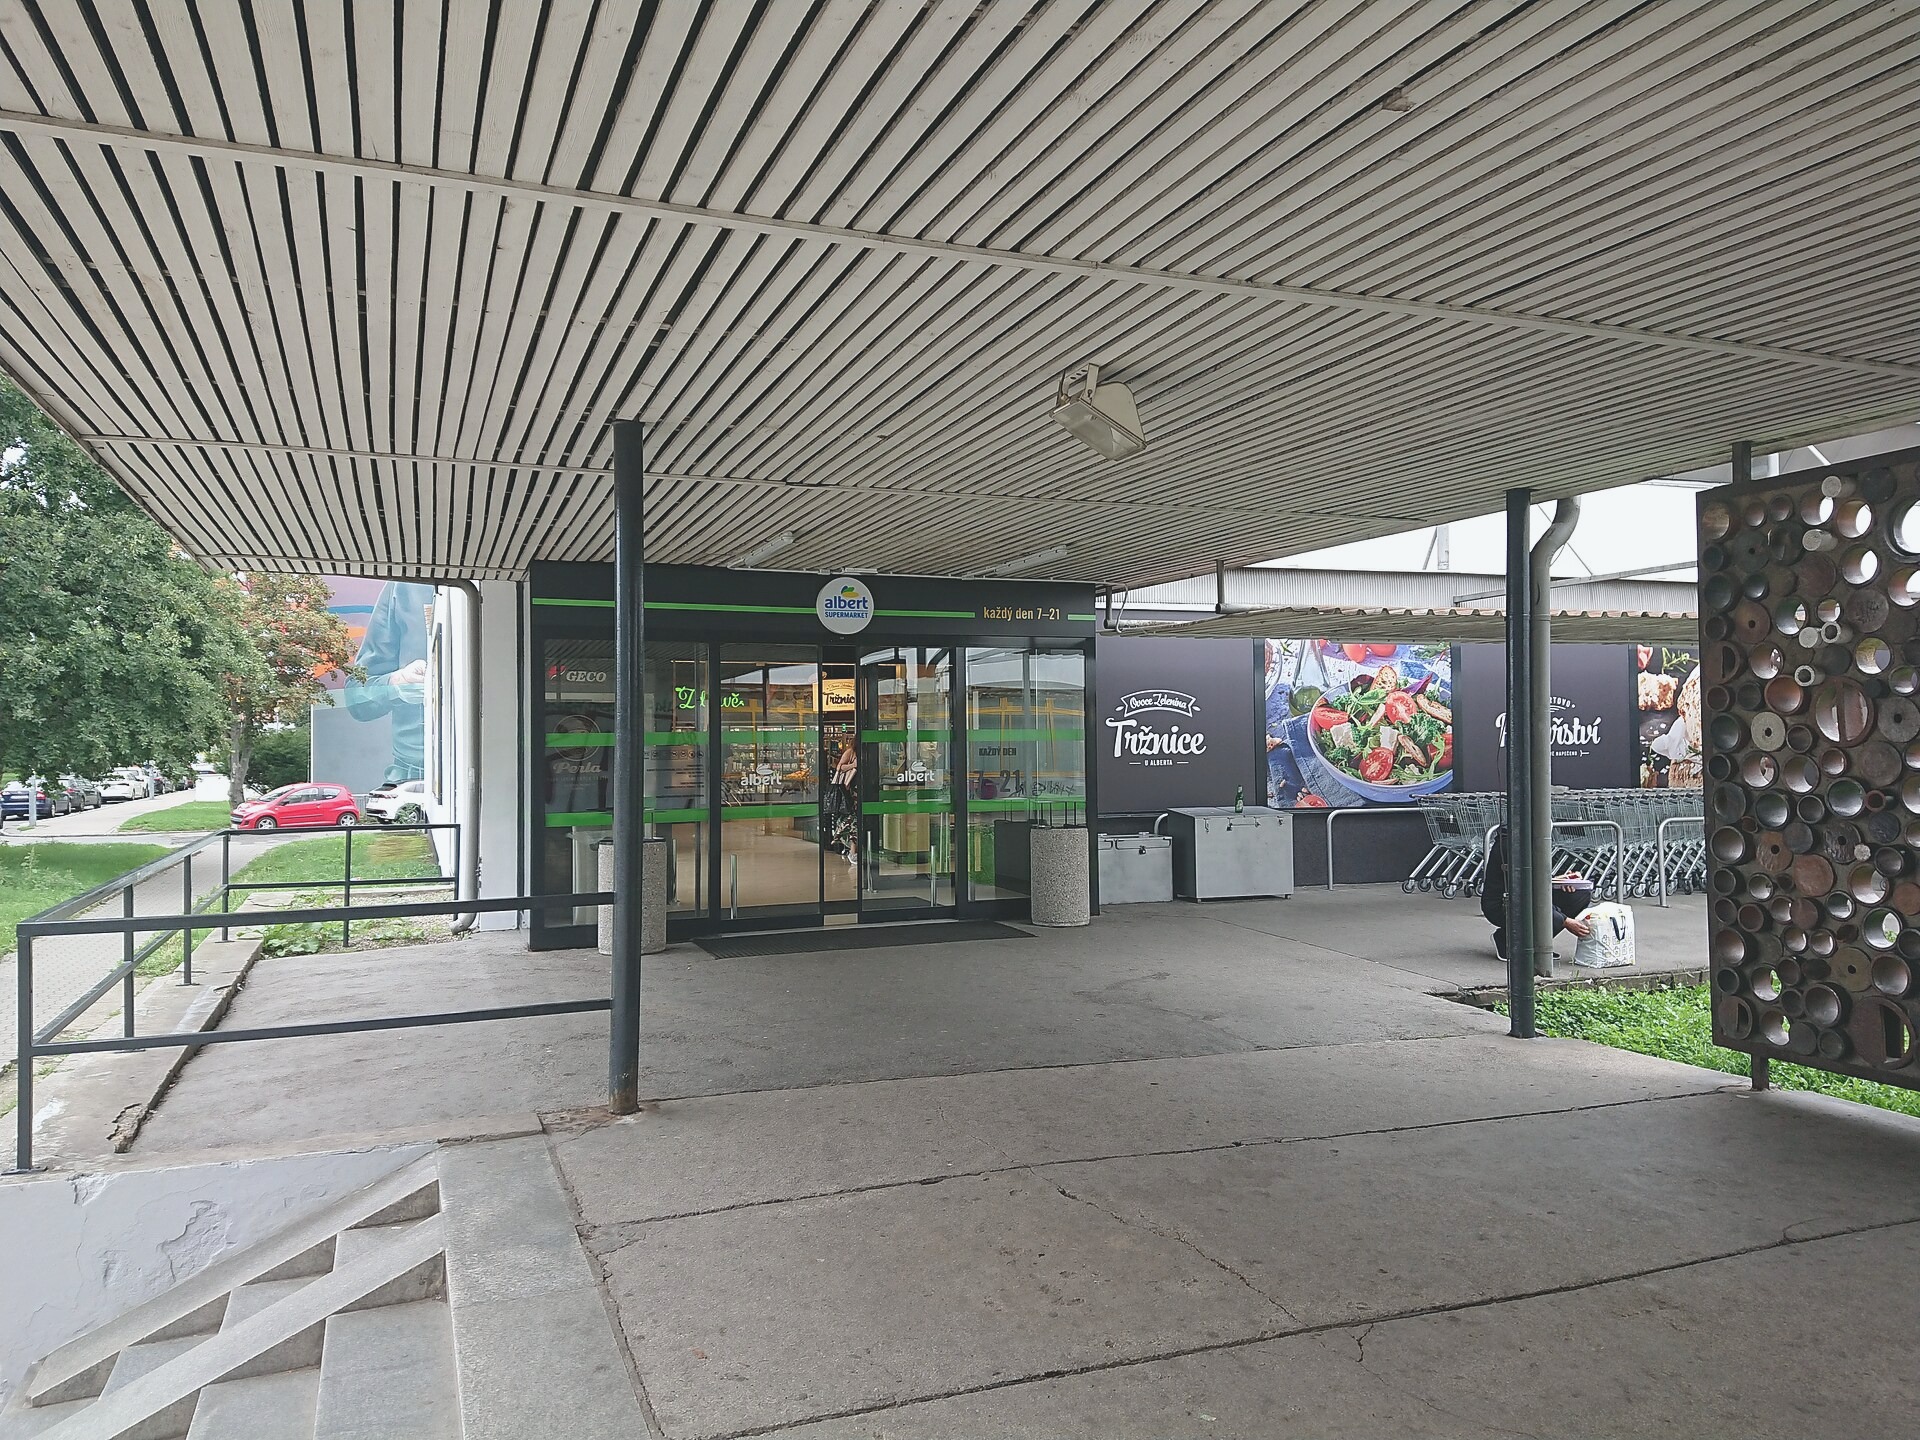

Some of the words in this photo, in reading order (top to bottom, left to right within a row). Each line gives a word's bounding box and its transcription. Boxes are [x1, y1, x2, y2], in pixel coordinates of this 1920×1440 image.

[824, 595, 869, 609] albert
[983, 606, 1013, 621] každý
[1015, 607, 1034, 620] den
[566, 670, 607, 682] GECO
[1130, 696, 1154, 709] Ovoce
[1152, 693, 1187, 709] Zelenina
[1105, 717, 1207, 758] Tržnice
[978, 745, 1000, 757] KAŽDÝ
[1002, 747, 1017, 757] DEN
[552, 761, 602, 774] Perla
[740, 771, 782, 786] albert
[897, 769, 935, 782] albert
